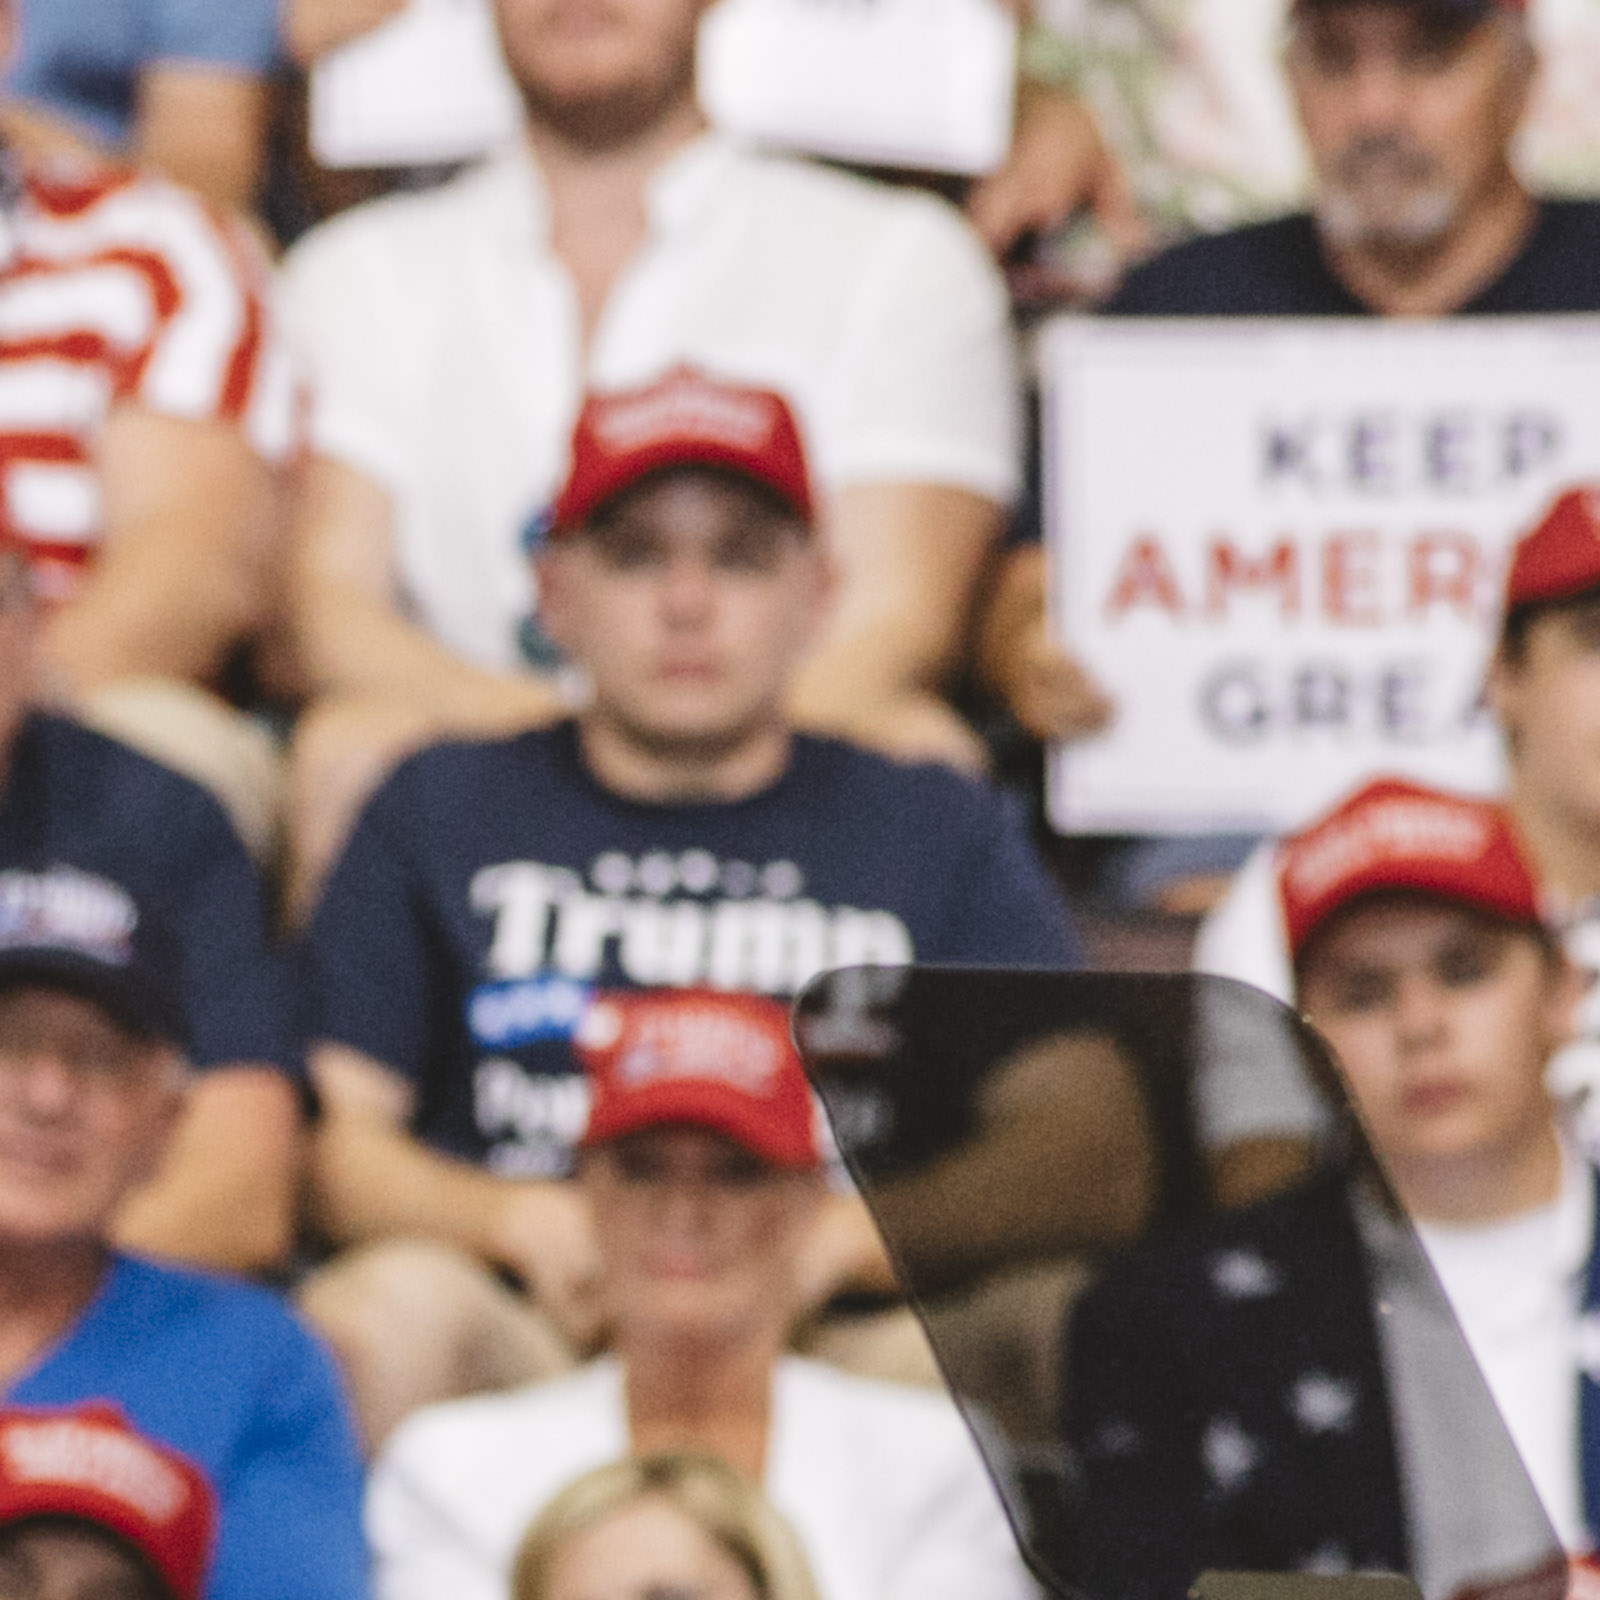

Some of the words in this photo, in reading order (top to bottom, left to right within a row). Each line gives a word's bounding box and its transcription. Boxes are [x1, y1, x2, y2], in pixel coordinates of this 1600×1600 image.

[1258, 408, 1558, 498] KEEP
[1102, 526, 1497, 628] AMER
[1196, 652, 1492, 748] GRE
